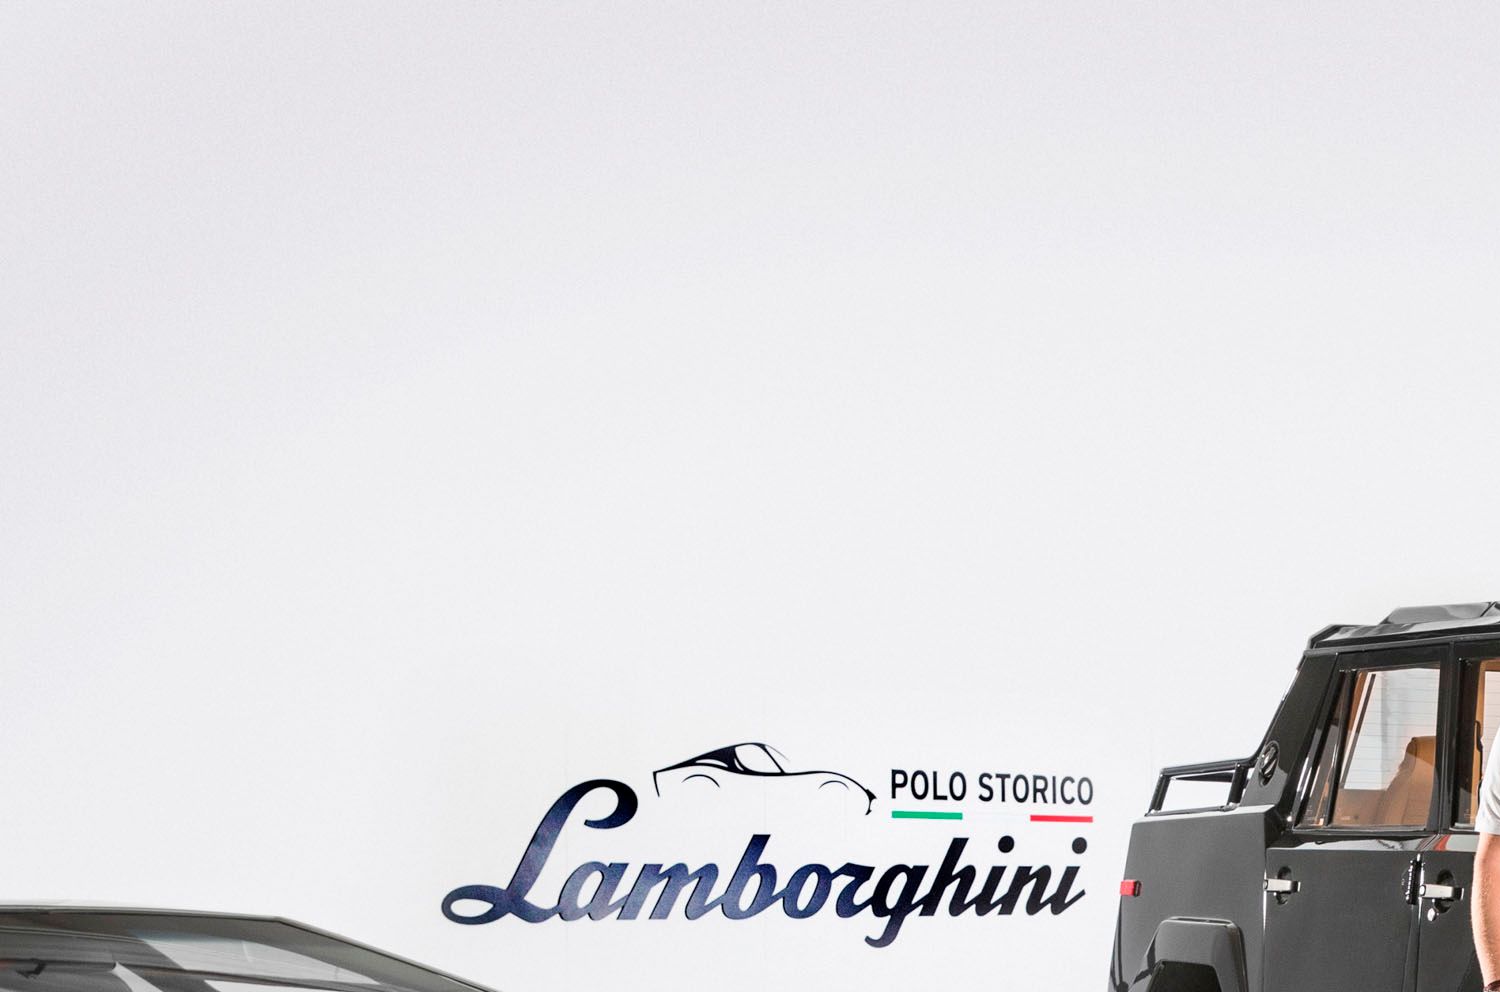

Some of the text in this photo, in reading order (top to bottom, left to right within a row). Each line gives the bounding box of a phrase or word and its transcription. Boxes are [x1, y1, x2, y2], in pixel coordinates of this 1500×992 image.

[891, 768, 1094, 806] POLO STORICO
[440, 778, 1088, 949] Lamborghini
